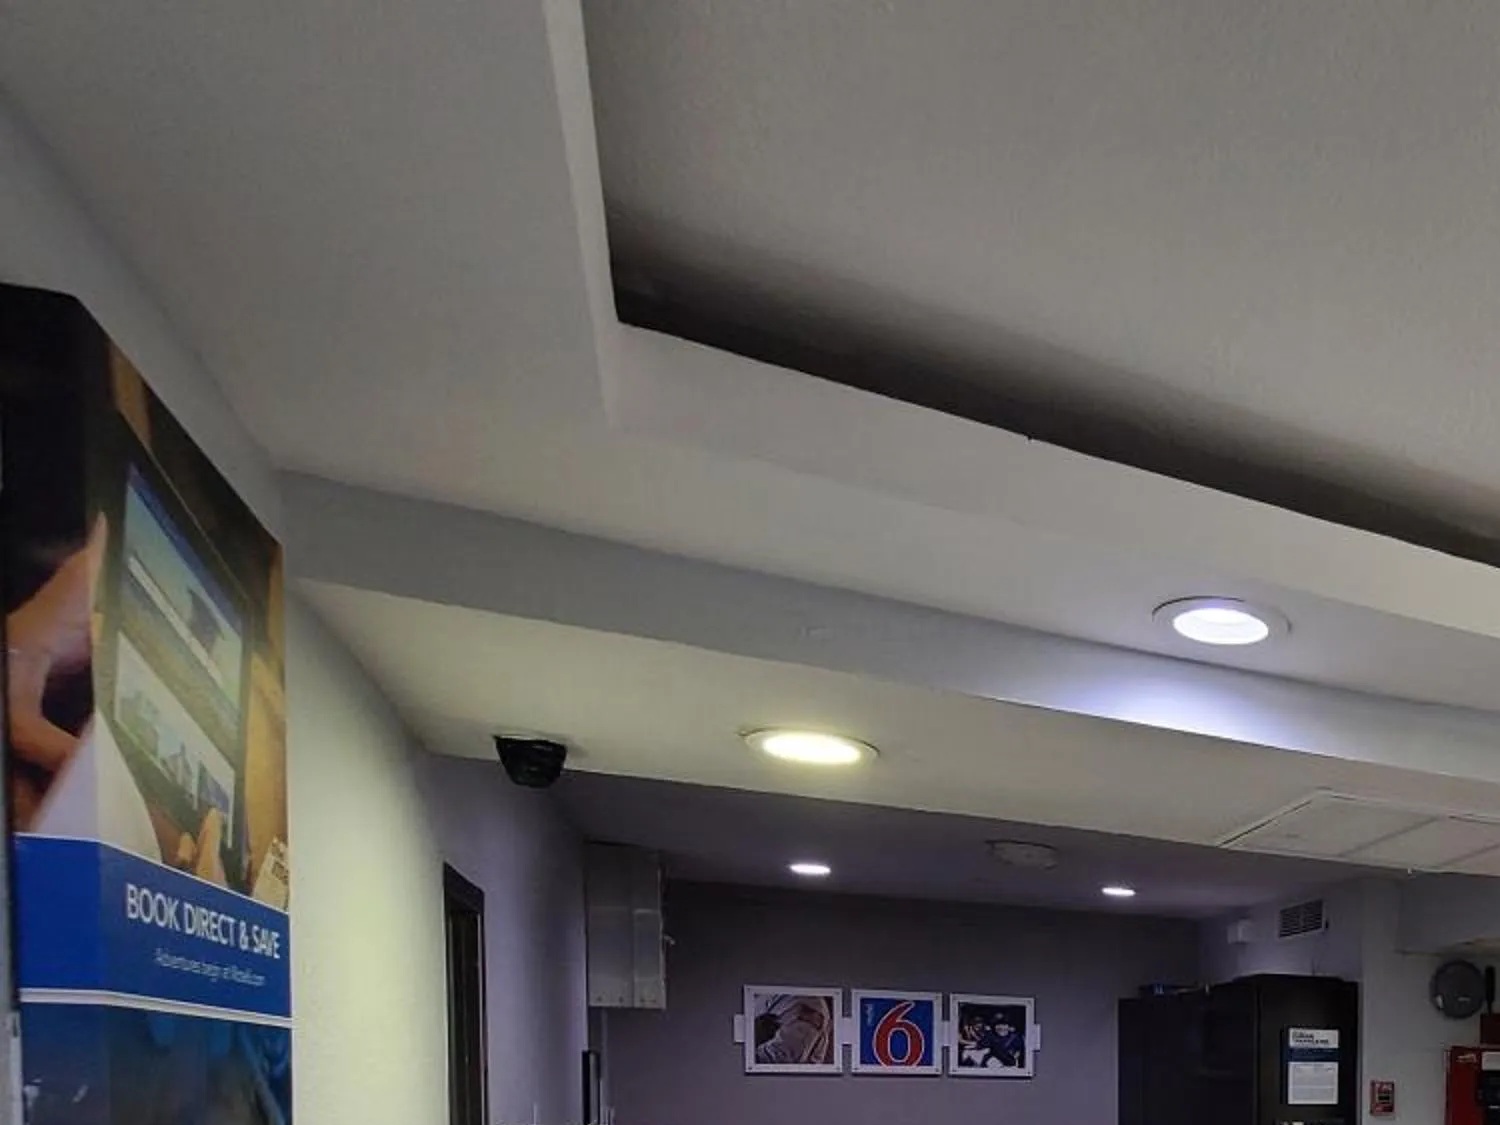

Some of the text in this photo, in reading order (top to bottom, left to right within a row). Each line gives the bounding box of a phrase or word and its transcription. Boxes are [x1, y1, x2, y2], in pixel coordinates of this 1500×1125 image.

[126, 883, 281, 959] BOOK DIRECT & SAVE
[872, 1001, 925, 1067] 6
